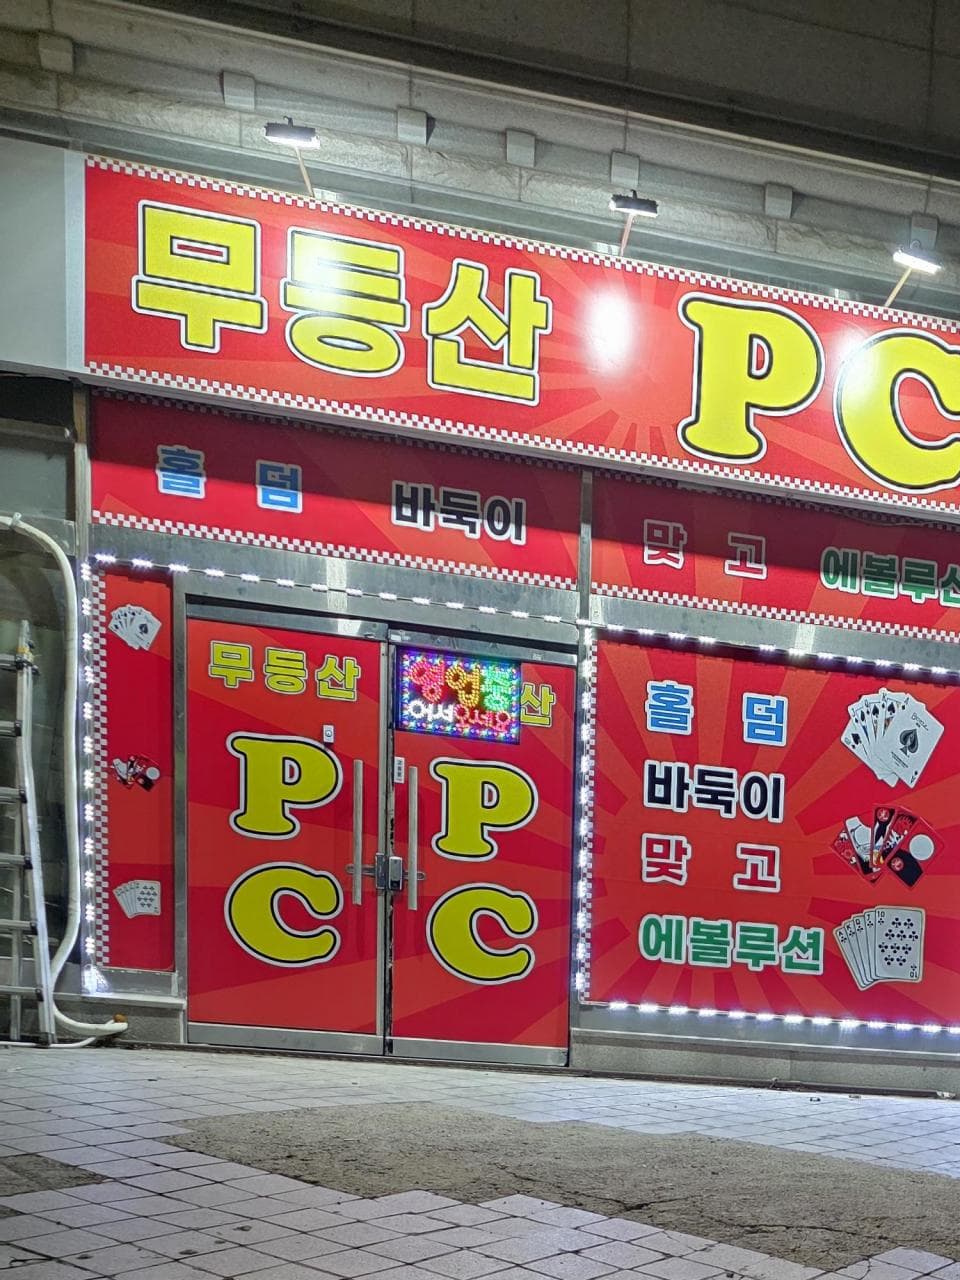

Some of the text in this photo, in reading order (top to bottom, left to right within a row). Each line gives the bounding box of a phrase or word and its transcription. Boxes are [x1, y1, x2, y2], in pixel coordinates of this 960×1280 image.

[132, 200, 551, 406] 무등산
[391, 481, 527, 545] 바둑이
[208, 640, 361, 702] 무등산
[407, 658, 513, 711] 영업중
[642, 760, 785, 822] 바둑이
[637, 914, 825, 977] 에볼루션
